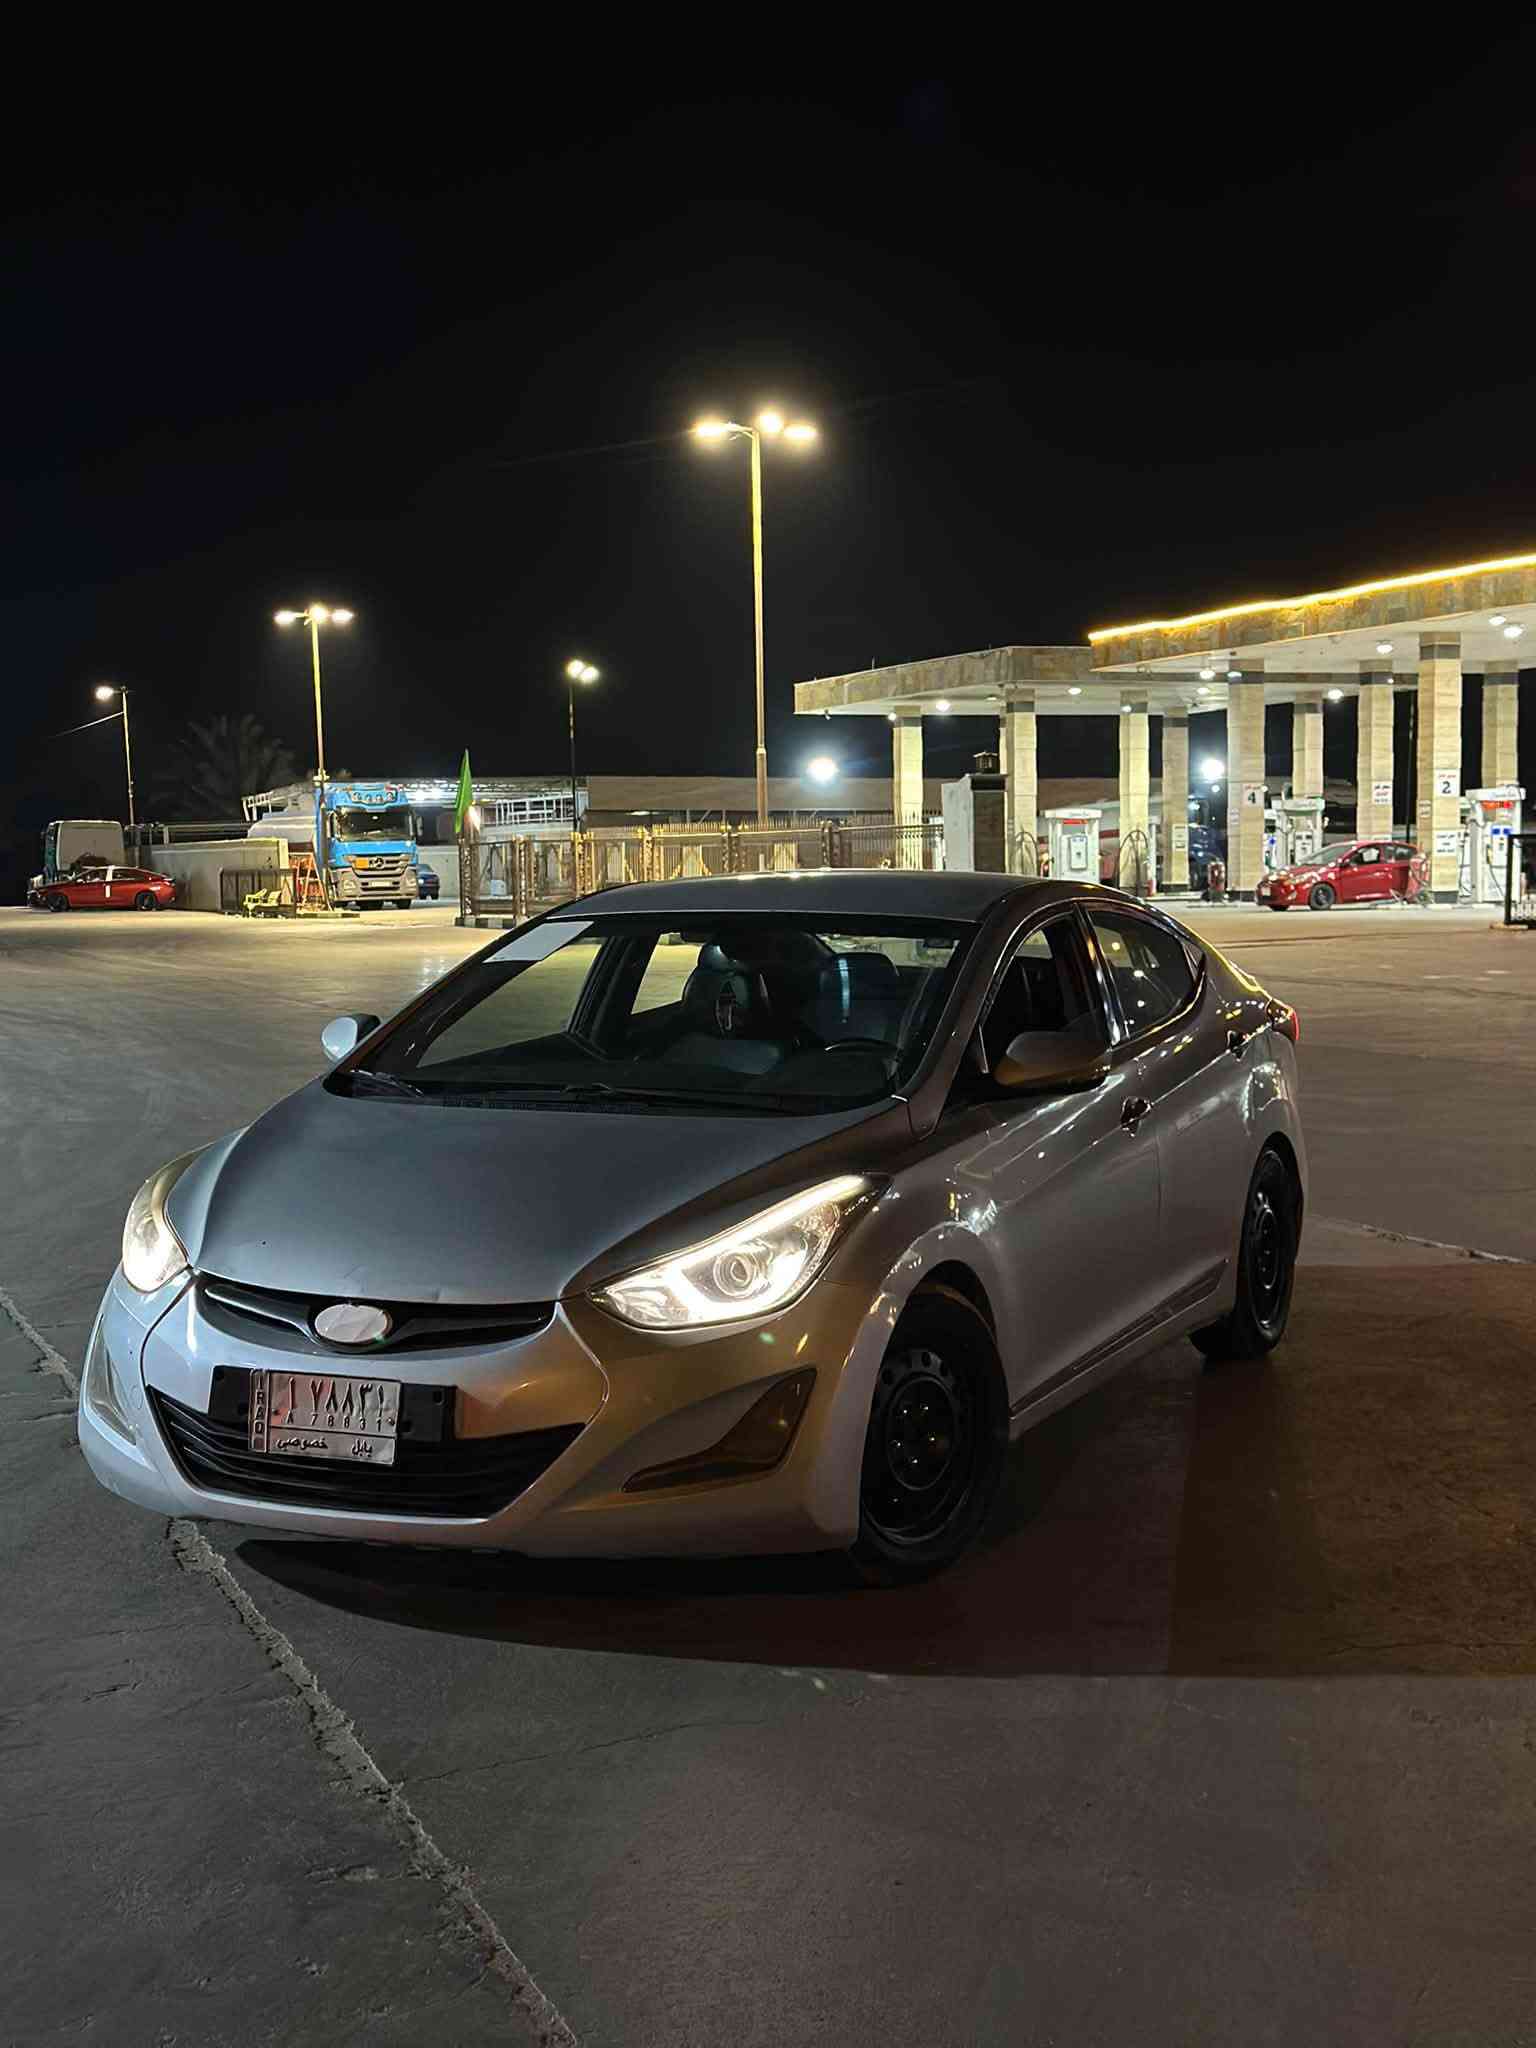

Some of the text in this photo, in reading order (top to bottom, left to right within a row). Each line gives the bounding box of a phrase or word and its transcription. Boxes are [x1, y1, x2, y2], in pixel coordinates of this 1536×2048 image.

[1442, 780, 1452, 795] 2
[1247, 791, 1256, 804] 4
[310, 1378, 385, 1418] ٧٨٨٣١
[311, 1412, 382, 1433] 78831
[276, 1435, 329, 1451] خصوصي
